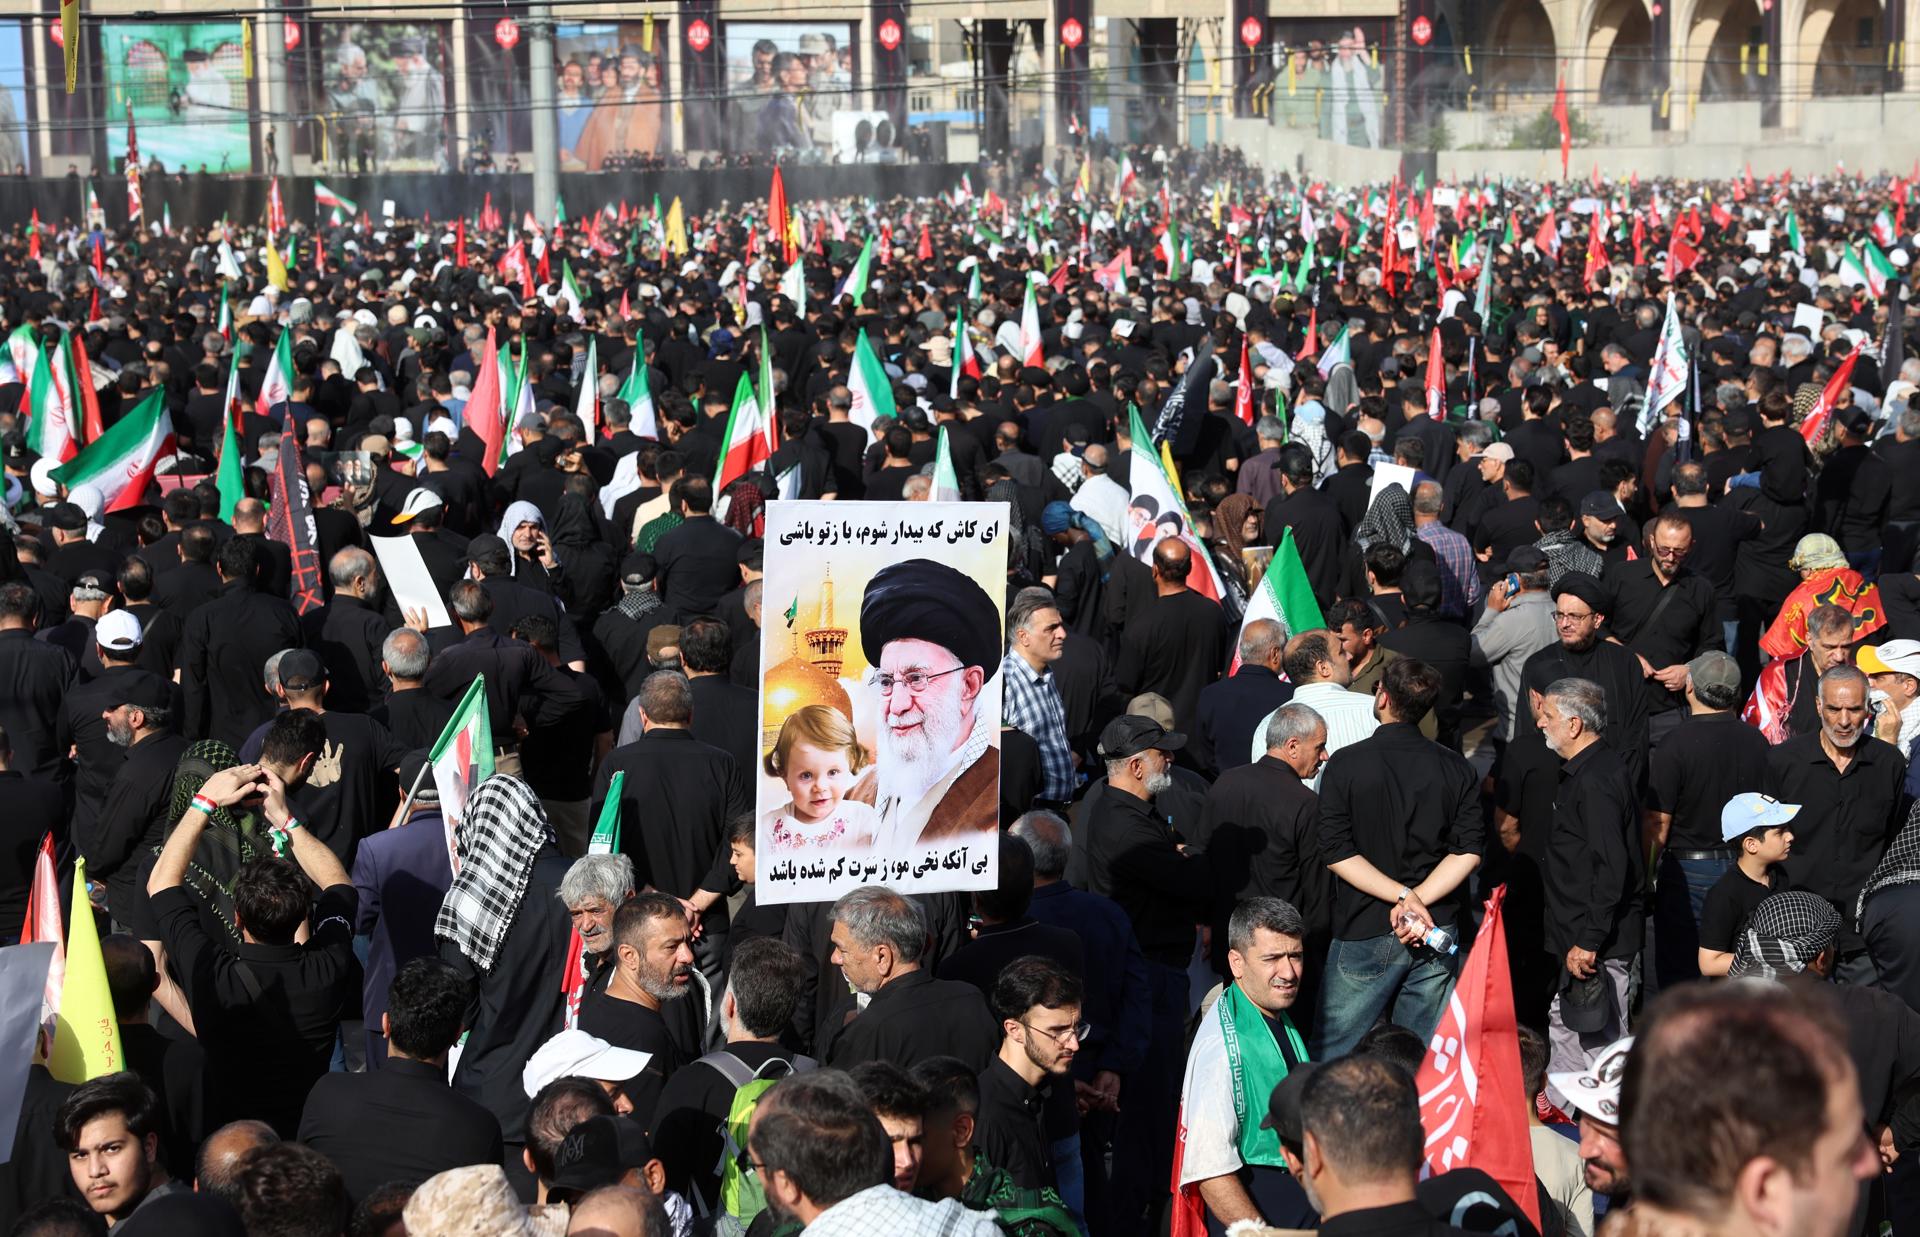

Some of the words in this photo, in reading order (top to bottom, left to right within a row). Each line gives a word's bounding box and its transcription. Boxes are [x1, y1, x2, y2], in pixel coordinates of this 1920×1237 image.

[779, 520, 814, 546] باشی
[890, 520, 924, 545] بیدار
[928, 520, 944, 539] که
[946, 519, 978, 545] کاش
[981, 519, 999, 545] ای
[800, 858, 826, 880] شده
[828, 856, 846, 884] کم
[912, 850, 939, 879] نخی
[941, 846, 969, 870] آنکه
[971, 854, 988, 875] بی
[769, 859, 797, 886] باشد
